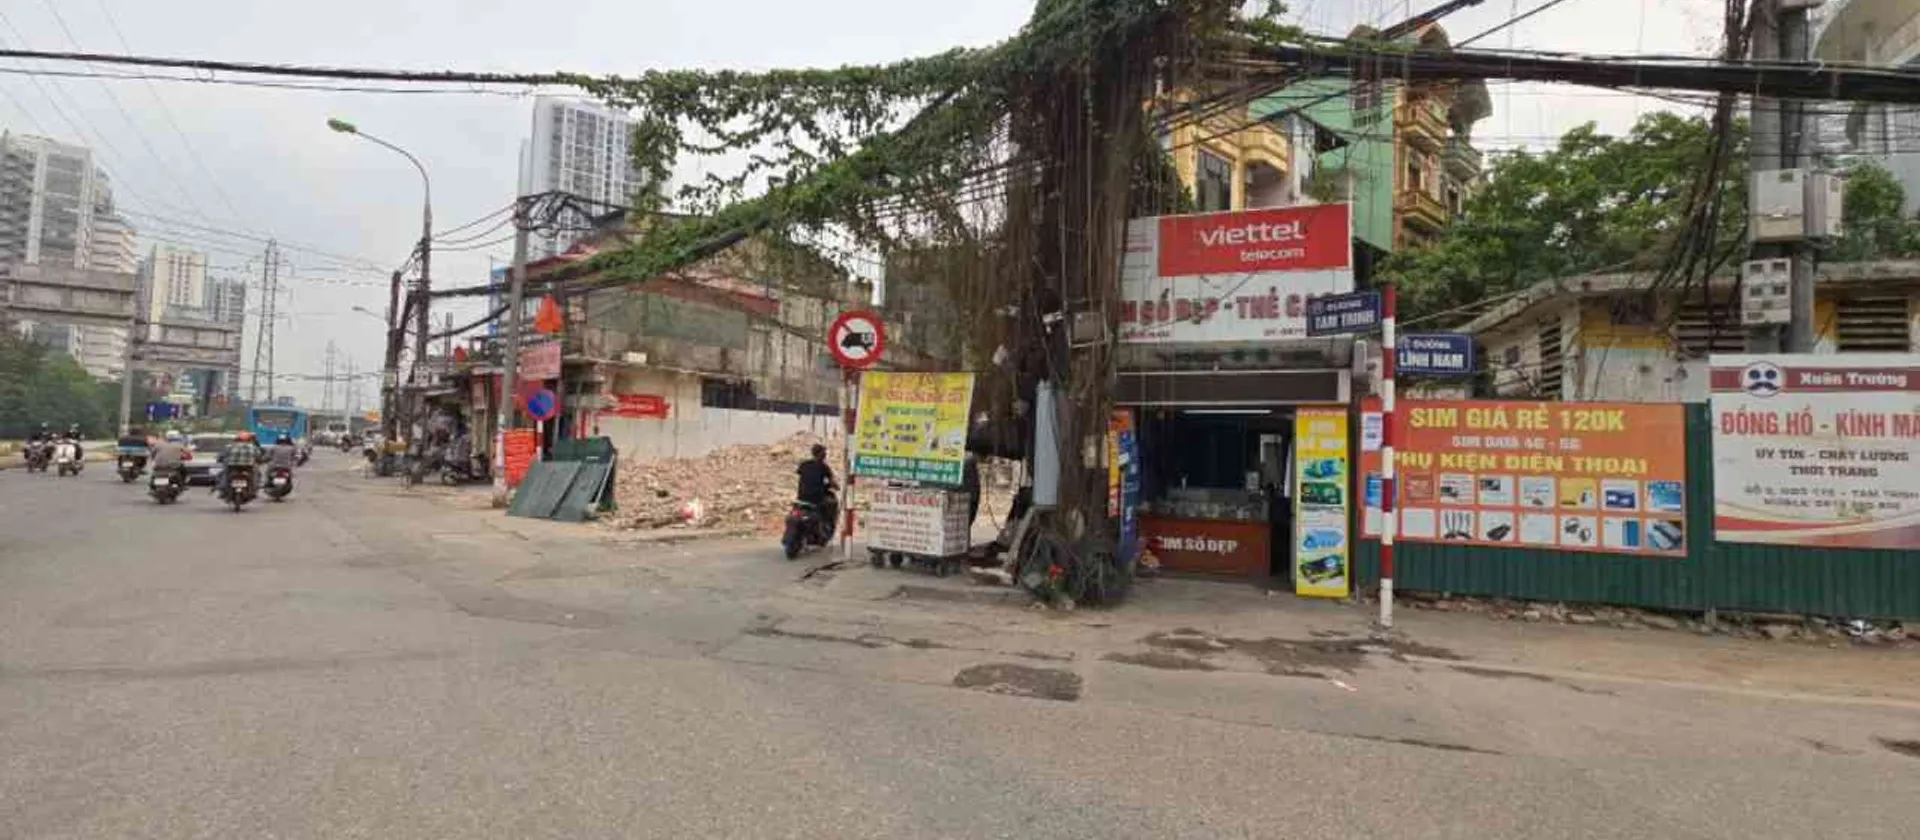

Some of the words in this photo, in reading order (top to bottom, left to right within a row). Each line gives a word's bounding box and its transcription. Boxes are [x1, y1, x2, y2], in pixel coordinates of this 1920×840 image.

[1200, 219, 1306, 247] viettel
[1240, 247, 1305, 263] telecom
[1236, 286, 1280, 319] THẺ
[1315, 315, 1339, 329] TAM
[1341, 309, 1376, 327] TRINH
[1432, 353, 1464, 369] NAM
[1799, 372, 1843, 386] Xuân
[1409, 408, 1458, 429] SIM
[1465, 405, 1509, 429] GIÁ
[1516, 401, 1550, 430] RẺ
[1559, 410, 1627, 432] 120K
[1452, 435, 1481, 448] SIM
[1485, 436, 1520, 449] DATA
[1755, 448, 1776, 460] UY
[1571, 455, 1649, 477] THOẠI
[1828, 465, 1879, 478] TRANG
